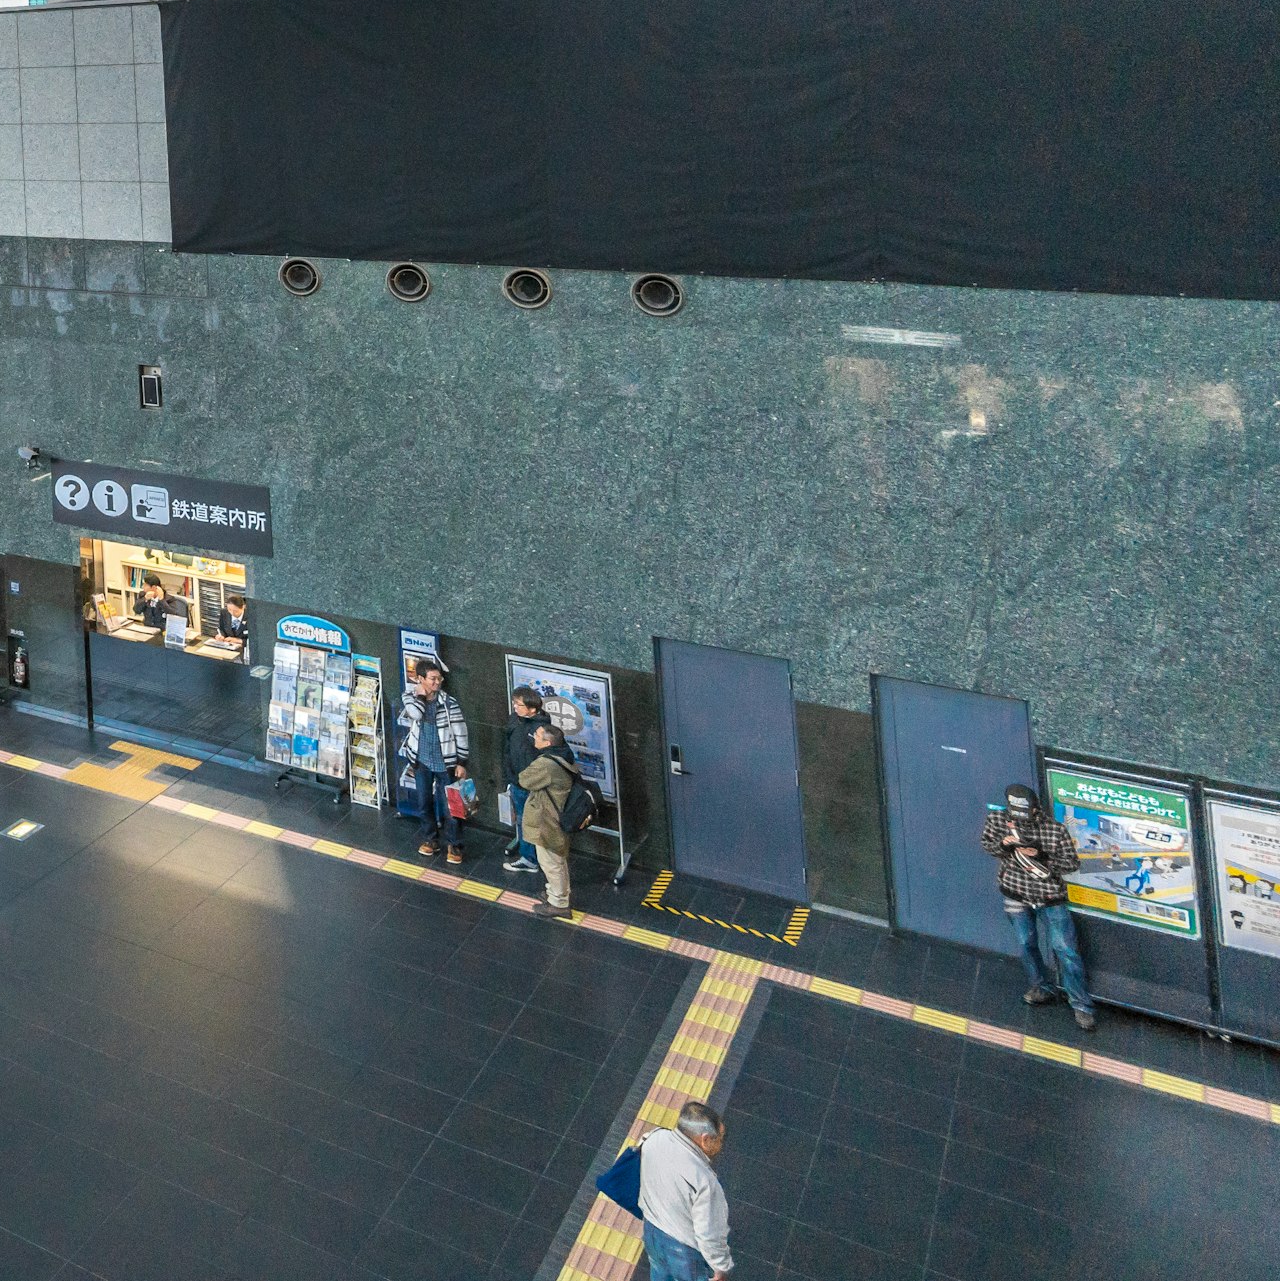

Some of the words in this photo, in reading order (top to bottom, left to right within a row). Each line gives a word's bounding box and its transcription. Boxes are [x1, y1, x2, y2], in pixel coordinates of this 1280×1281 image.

[171, 498, 267, 532] 鉄道案内所
[283, 623, 342, 646] おでかけ情報
[412, 638, 433, 649] Navi
[1057, 787, 1182, 820] ホームを歩くときは気をつけて。
[1076, 783, 1160, 806] おとなもこどもも
